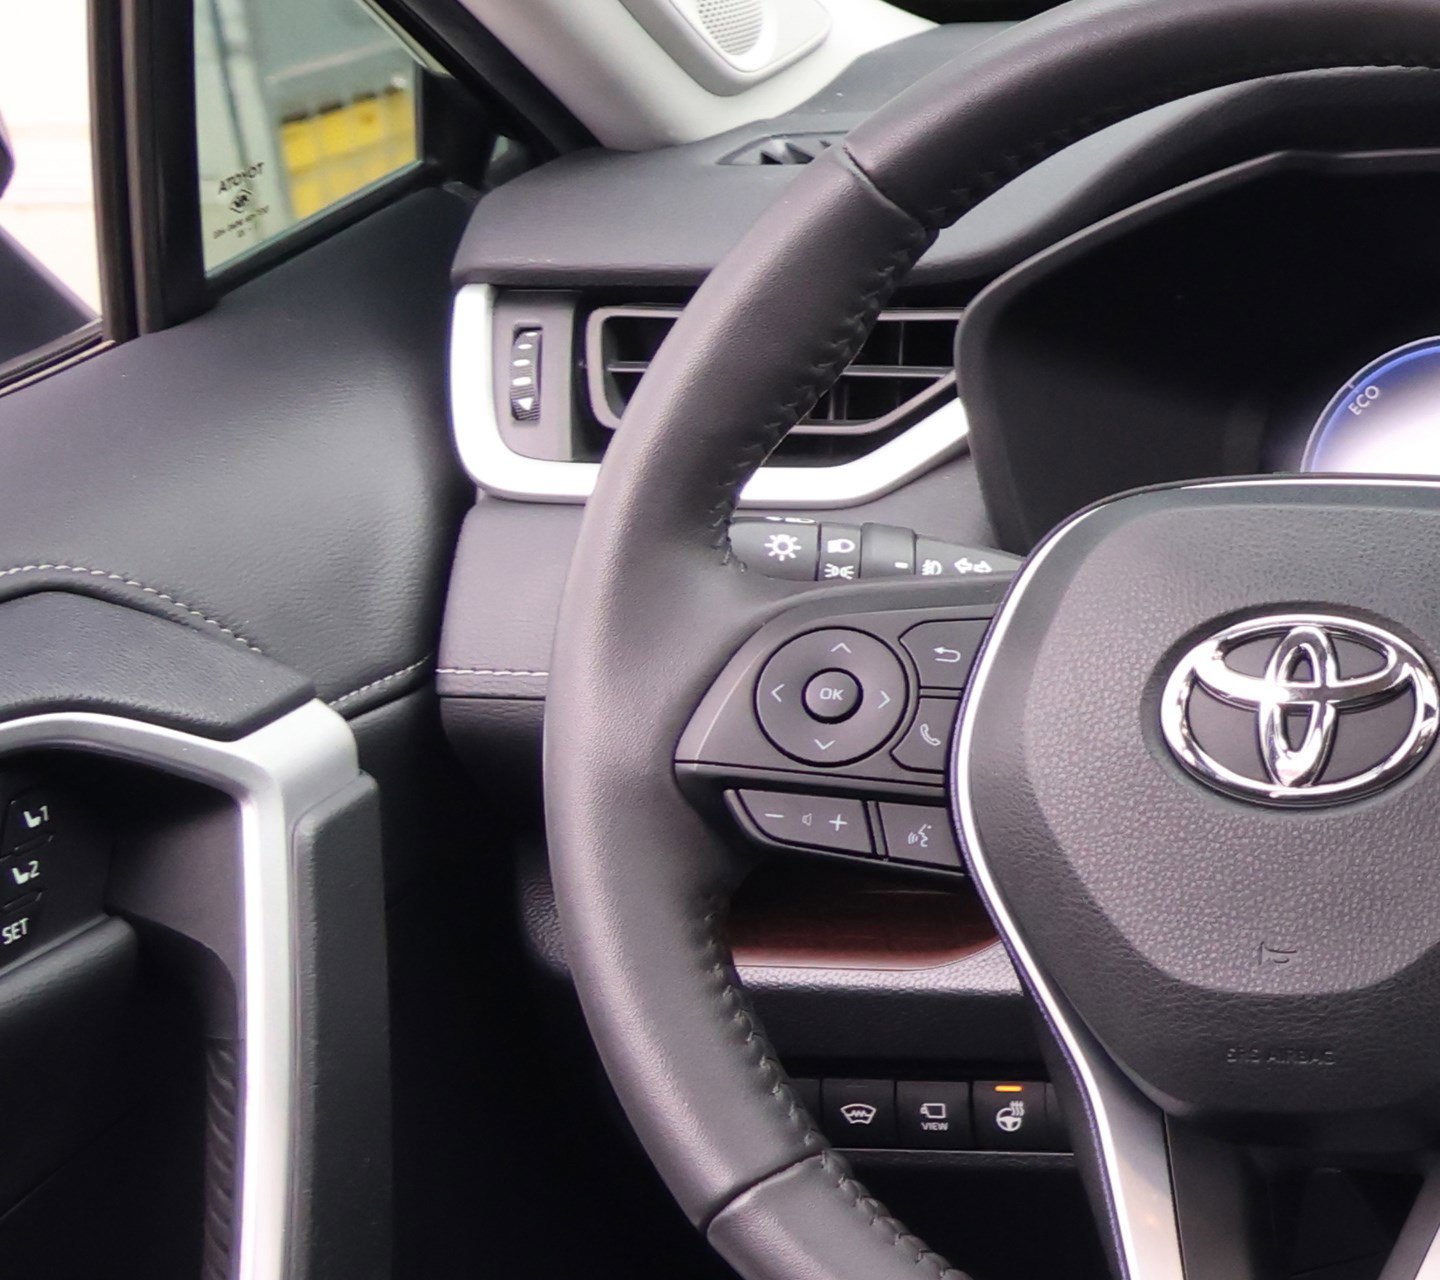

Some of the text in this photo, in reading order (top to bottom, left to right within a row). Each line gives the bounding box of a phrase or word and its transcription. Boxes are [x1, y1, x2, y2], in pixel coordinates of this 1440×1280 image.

[1347, 384, 1381, 416] ECO
[820, 688, 843, 701] OK
[1, 917, 29, 945] SET
[920, 1121, 948, 1131] VIEW
